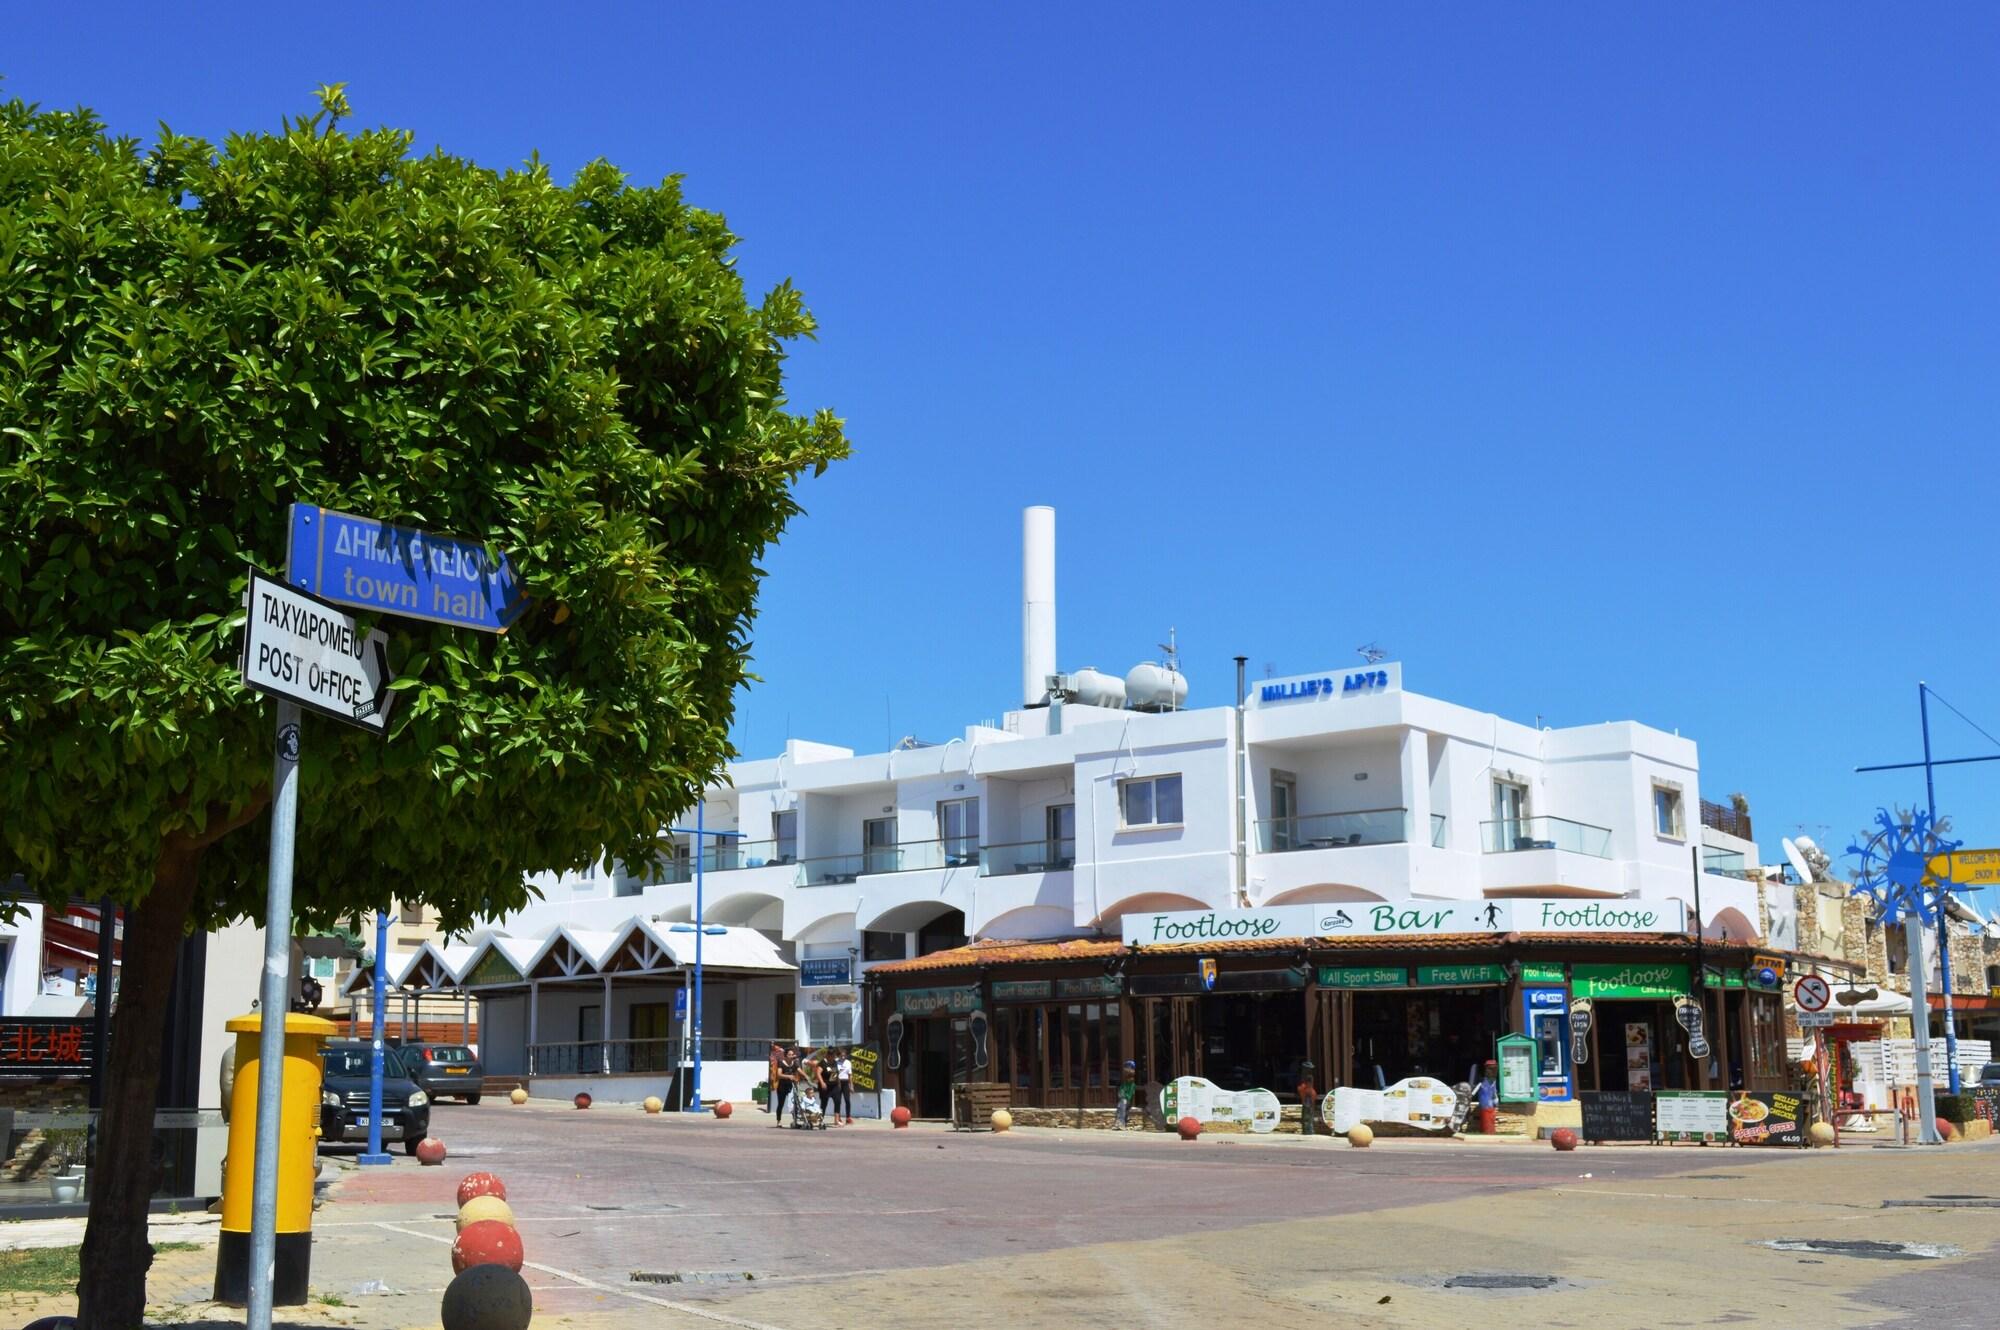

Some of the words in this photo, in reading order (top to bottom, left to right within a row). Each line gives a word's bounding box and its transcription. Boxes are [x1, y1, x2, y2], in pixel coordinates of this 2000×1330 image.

[343, 566, 417, 608] town
[433, 584, 485, 621] hall
[262, 592, 364, 661] ΤΑΧΥΔΡΟΜΕΙΟ
[258, 642, 304, 685] POST
[308, 662, 362, 706] OFFICE
[1261, 677, 1333, 702] MILLIE'S
[1152, 912, 1281, 940] Footloose
[1370, 905, 1454, 932] Bar
[1541, 902, 1659, 929] Footloose
[1523, 965, 1540, 977] Pool
[1756, 957, 1783, 969] ATM
[1328, 972, 1340, 983] All
[1343, 971, 1370, 984] Sport
[1374, 970, 1399, 982] Show
[1431, 969, 1457, 981] Free
[1459, 967, 1491, 980] Wi-Fi
[1588, 968, 1673, 995] Footloose
[677, 989, 685, 1007] P
[904, 991, 951, 1010] Karaoke
[953, 990, 976, 1008] Bar
[0, 1024, 82, 1062] 北城
[1773, 1093, 1800, 1106] GRILLED
[1774, 1101, 1796, 1112] ROAST
[1769, 1107, 1797, 1120] CHICKEN
